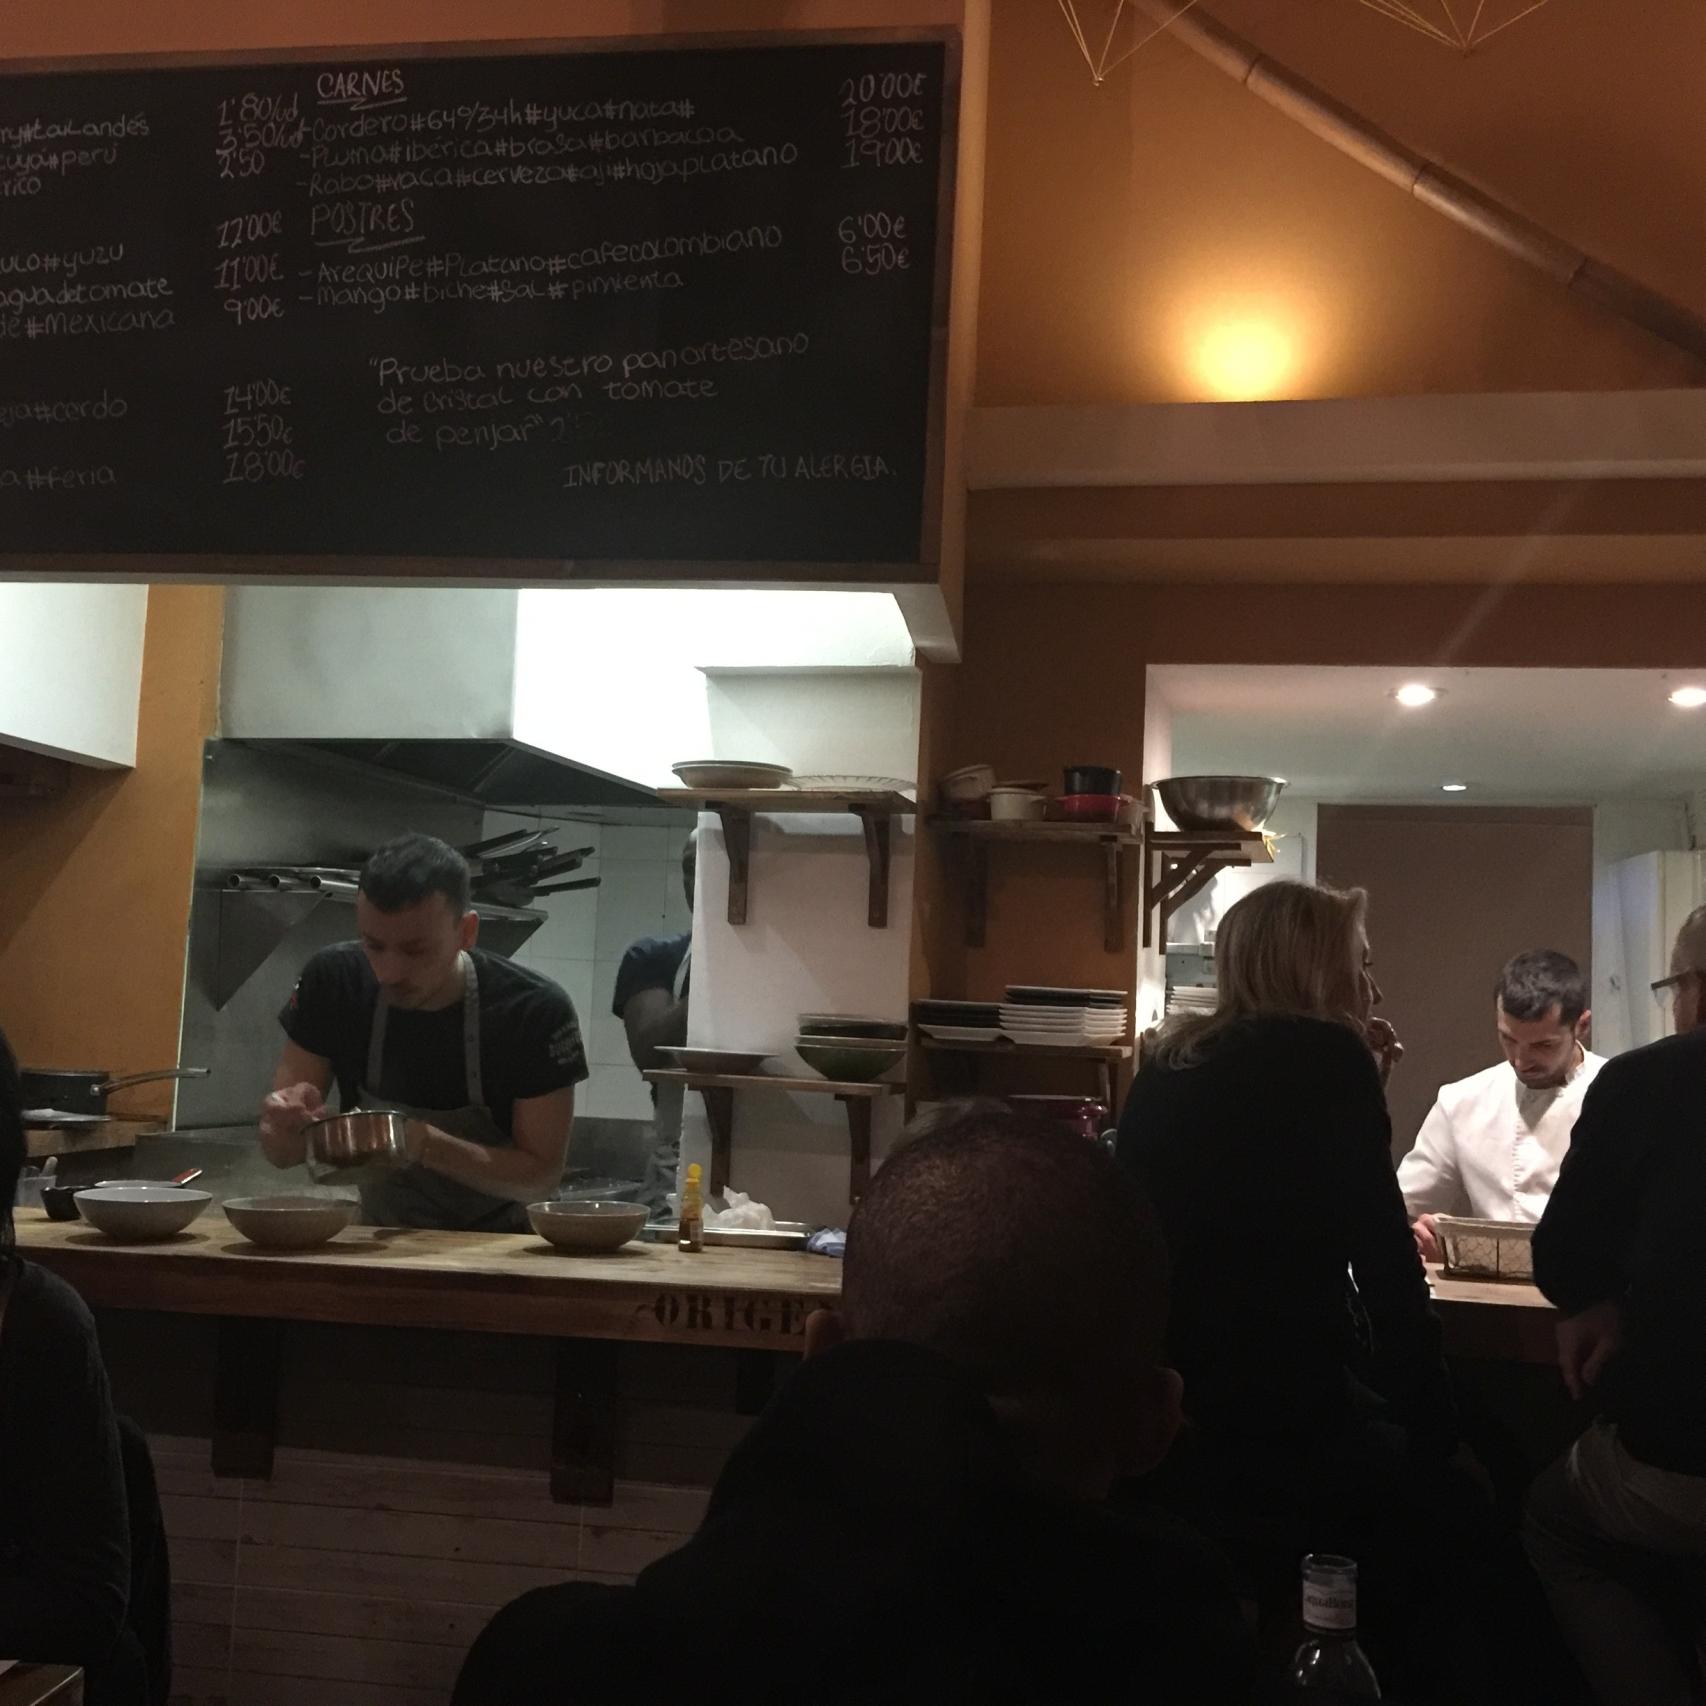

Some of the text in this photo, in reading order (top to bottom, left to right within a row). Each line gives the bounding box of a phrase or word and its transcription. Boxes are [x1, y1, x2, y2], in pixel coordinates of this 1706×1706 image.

[317, 69, 404, 98] CARNES
[311, 200, 414, 236] POSTRES
[838, 212, 906, 244] 6'00€
[841, 242, 911, 275] 6'50€
[496, 354, 613, 376] nuestro
[377, 389, 413, 415] de
[528, 382, 582, 404] con
[603, 379, 719, 400] tomate
[386, 420, 423, 444] de
[562, 455, 706, 488] INFORMANOS
[717, 458, 752, 483] DE
[757, 453, 786, 478] TU
